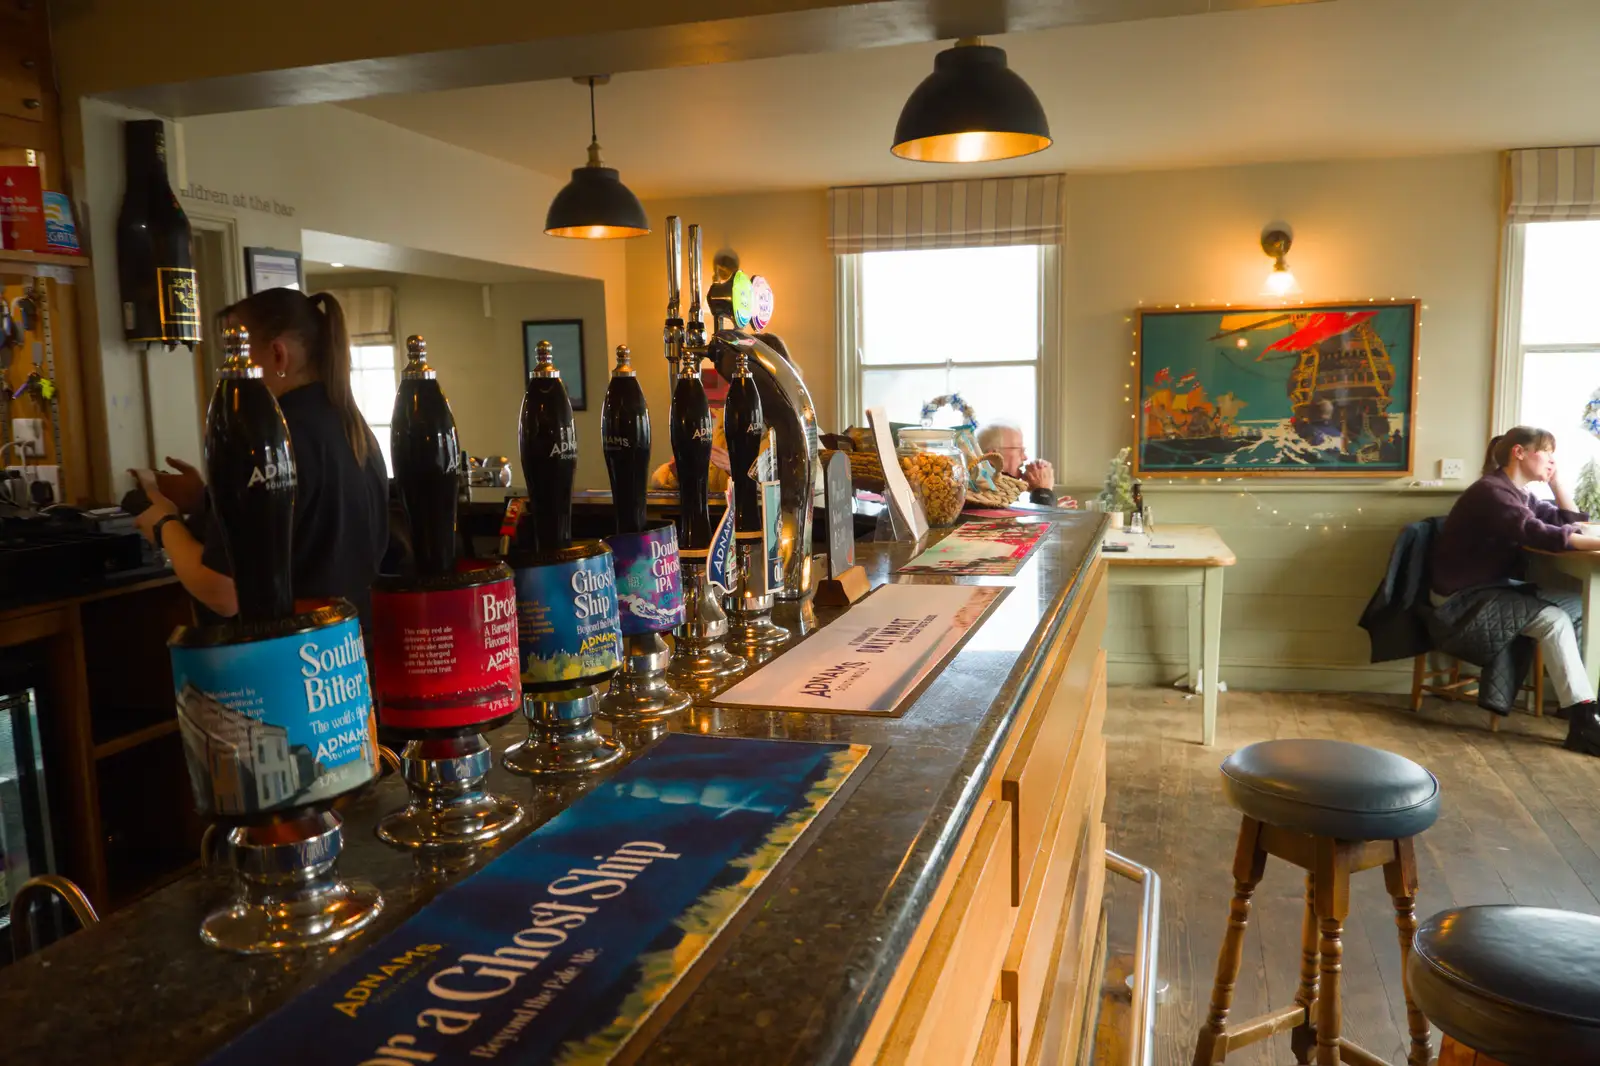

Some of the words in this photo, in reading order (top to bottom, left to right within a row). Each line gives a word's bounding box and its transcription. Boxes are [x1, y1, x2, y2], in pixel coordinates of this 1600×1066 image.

[232, 192, 247, 208] at
[249, 196, 271, 213] the
[272, 199, 296, 217] bar
[713, 510, 735, 576] ADNAMS
[655, 575, 673, 594] IPA
[574, 593, 610, 619] Ship
[431, 626, 442, 634] red
[484, 625, 490, 638] A
[874, 617, 919, 638] IMPACT
[426, 649, 450, 658] charged
[580, 632, 617, 655] ADNAMS
[855, 637, 897, 653] ONLY
[304, 673, 362, 714] Bitter
[309, 719, 330, 736] The
[315, 727, 369, 764] ADNAMS
[547, 840, 681, 901] Ship
[426, 901, 599, 1001] Ghost
[416, 1007, 482, 1035] a
[469, 1008, 540, 1059] Beyond
[521, 989, 558, 1011] the
[542, 965, 584, 991] Pale
